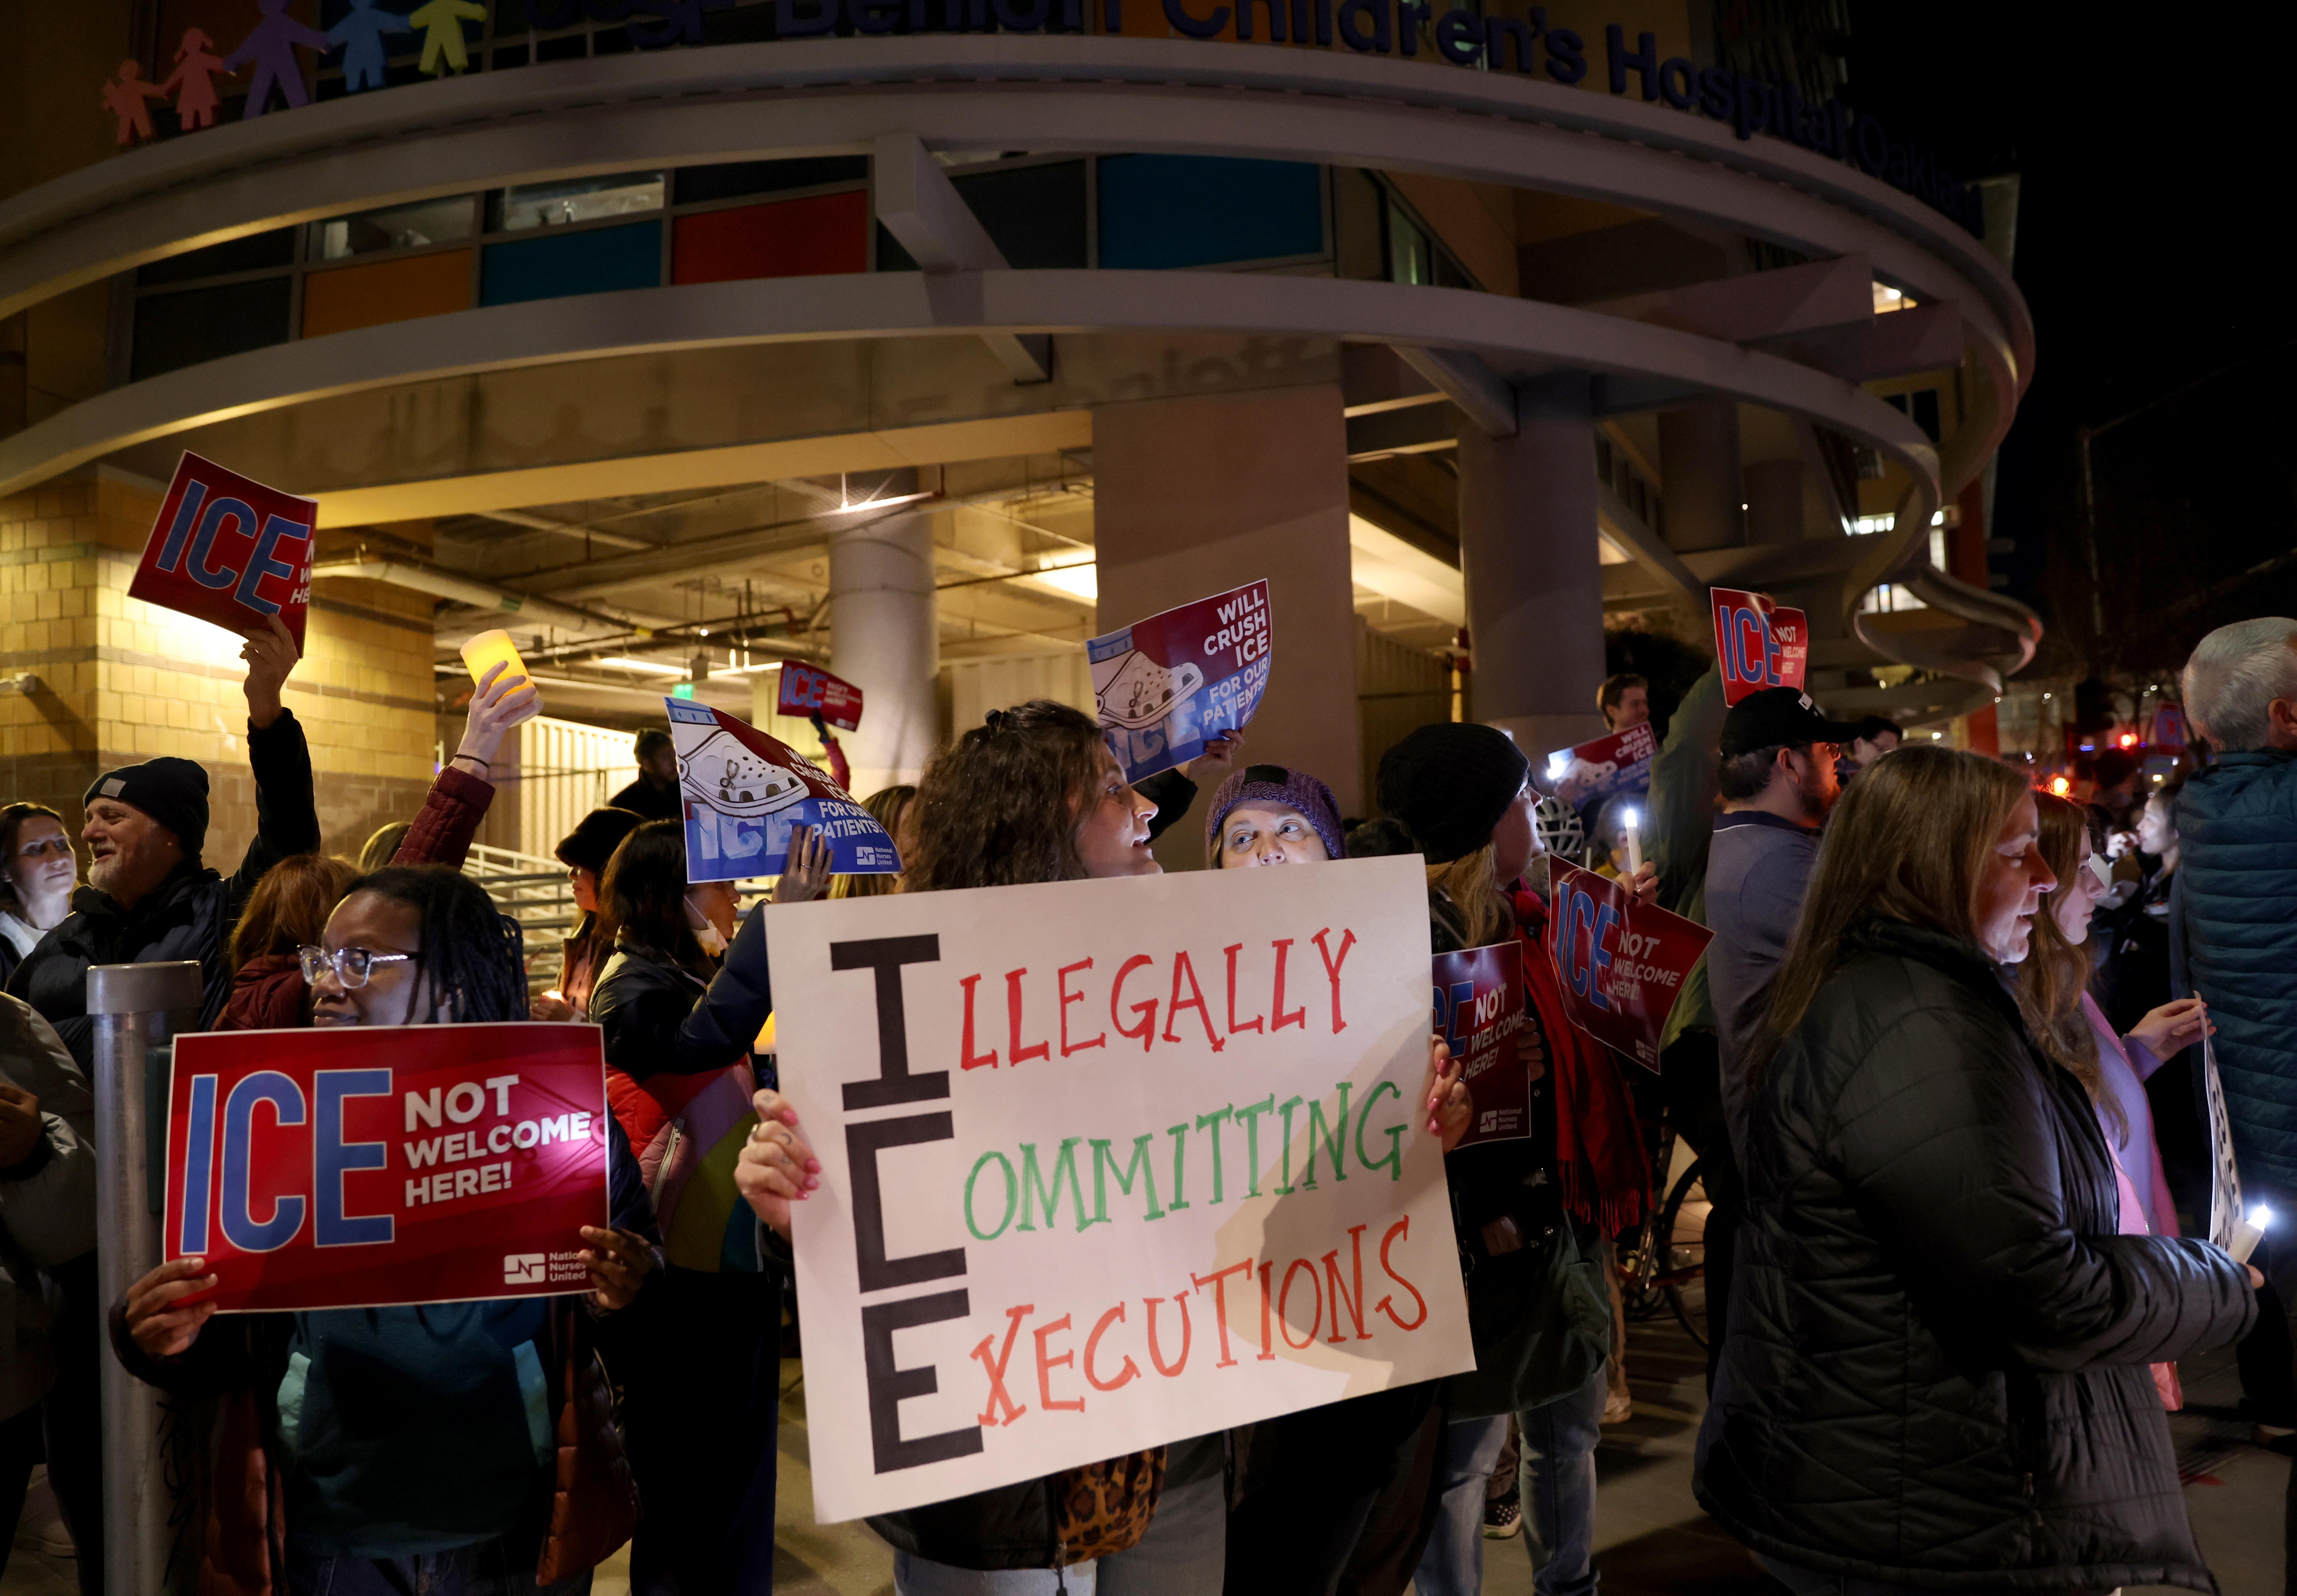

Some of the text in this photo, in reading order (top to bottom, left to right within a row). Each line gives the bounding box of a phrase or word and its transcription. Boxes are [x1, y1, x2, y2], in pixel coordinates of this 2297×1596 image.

[1606, 23, 1849, 158] Hospital
[1855, 111, 1983, 238] Oakland
[156, 478, 310, 616] ICE
[1217, 589, 1264, 625] WILL
[1204, 608, 1266, 656] CRUSH
[1235, 629, 1268, 668] ICE
[1720, 605, 1781, 687] ICE
[1775, 626, 1796, 642] NOT
[782, 666, 827, 708] ICE
[1209, 656, 1268, 703] FOR OUR
[1203, 673, 1266, 726] PATIENTS!
[1107, 700, 1201, 769] ICE
[1615, 735, 1651, 758] CRUSH
[1621, 727, 1649, 743] WILL
[1632, 744, 1654, 761] ICE
[783, 748, 818, 768] WIL
[790, 762, 839, 786] CRUSH
[818, 802, 871, 818] FOR OUR
[821, 783, 856, 803] ICE
[691, 803, 803, 860] ICE
[811, 819, 883, 841] PATIENTS!
[1555, 880, 1620, 1013] ICE
[1618, 930, 1661, 959] NOT
[1613, 980, 1641, 1000] HERE!
[1614, 958, 1681, 987] WELCOME
[1433, 980, 1473, 1059] CE
[1473, 982, 1507, 1027] NOT
[1471, 1007, 1526, 1055] WELCOME
[1464, 1046, 1500, 1084] HERE!
[404, 1074, 519, 1133] NOT
[1499, 1107, 1522, 1116] National
[404, 1111, 592, 1169] WELCOME
[180, 1067, 394, 1256] ICE
[405, 1161, 512, 1207] HERE!
[549, 1262, 587, 1272] Nurses
[549, 1270, 587, 1282] United
